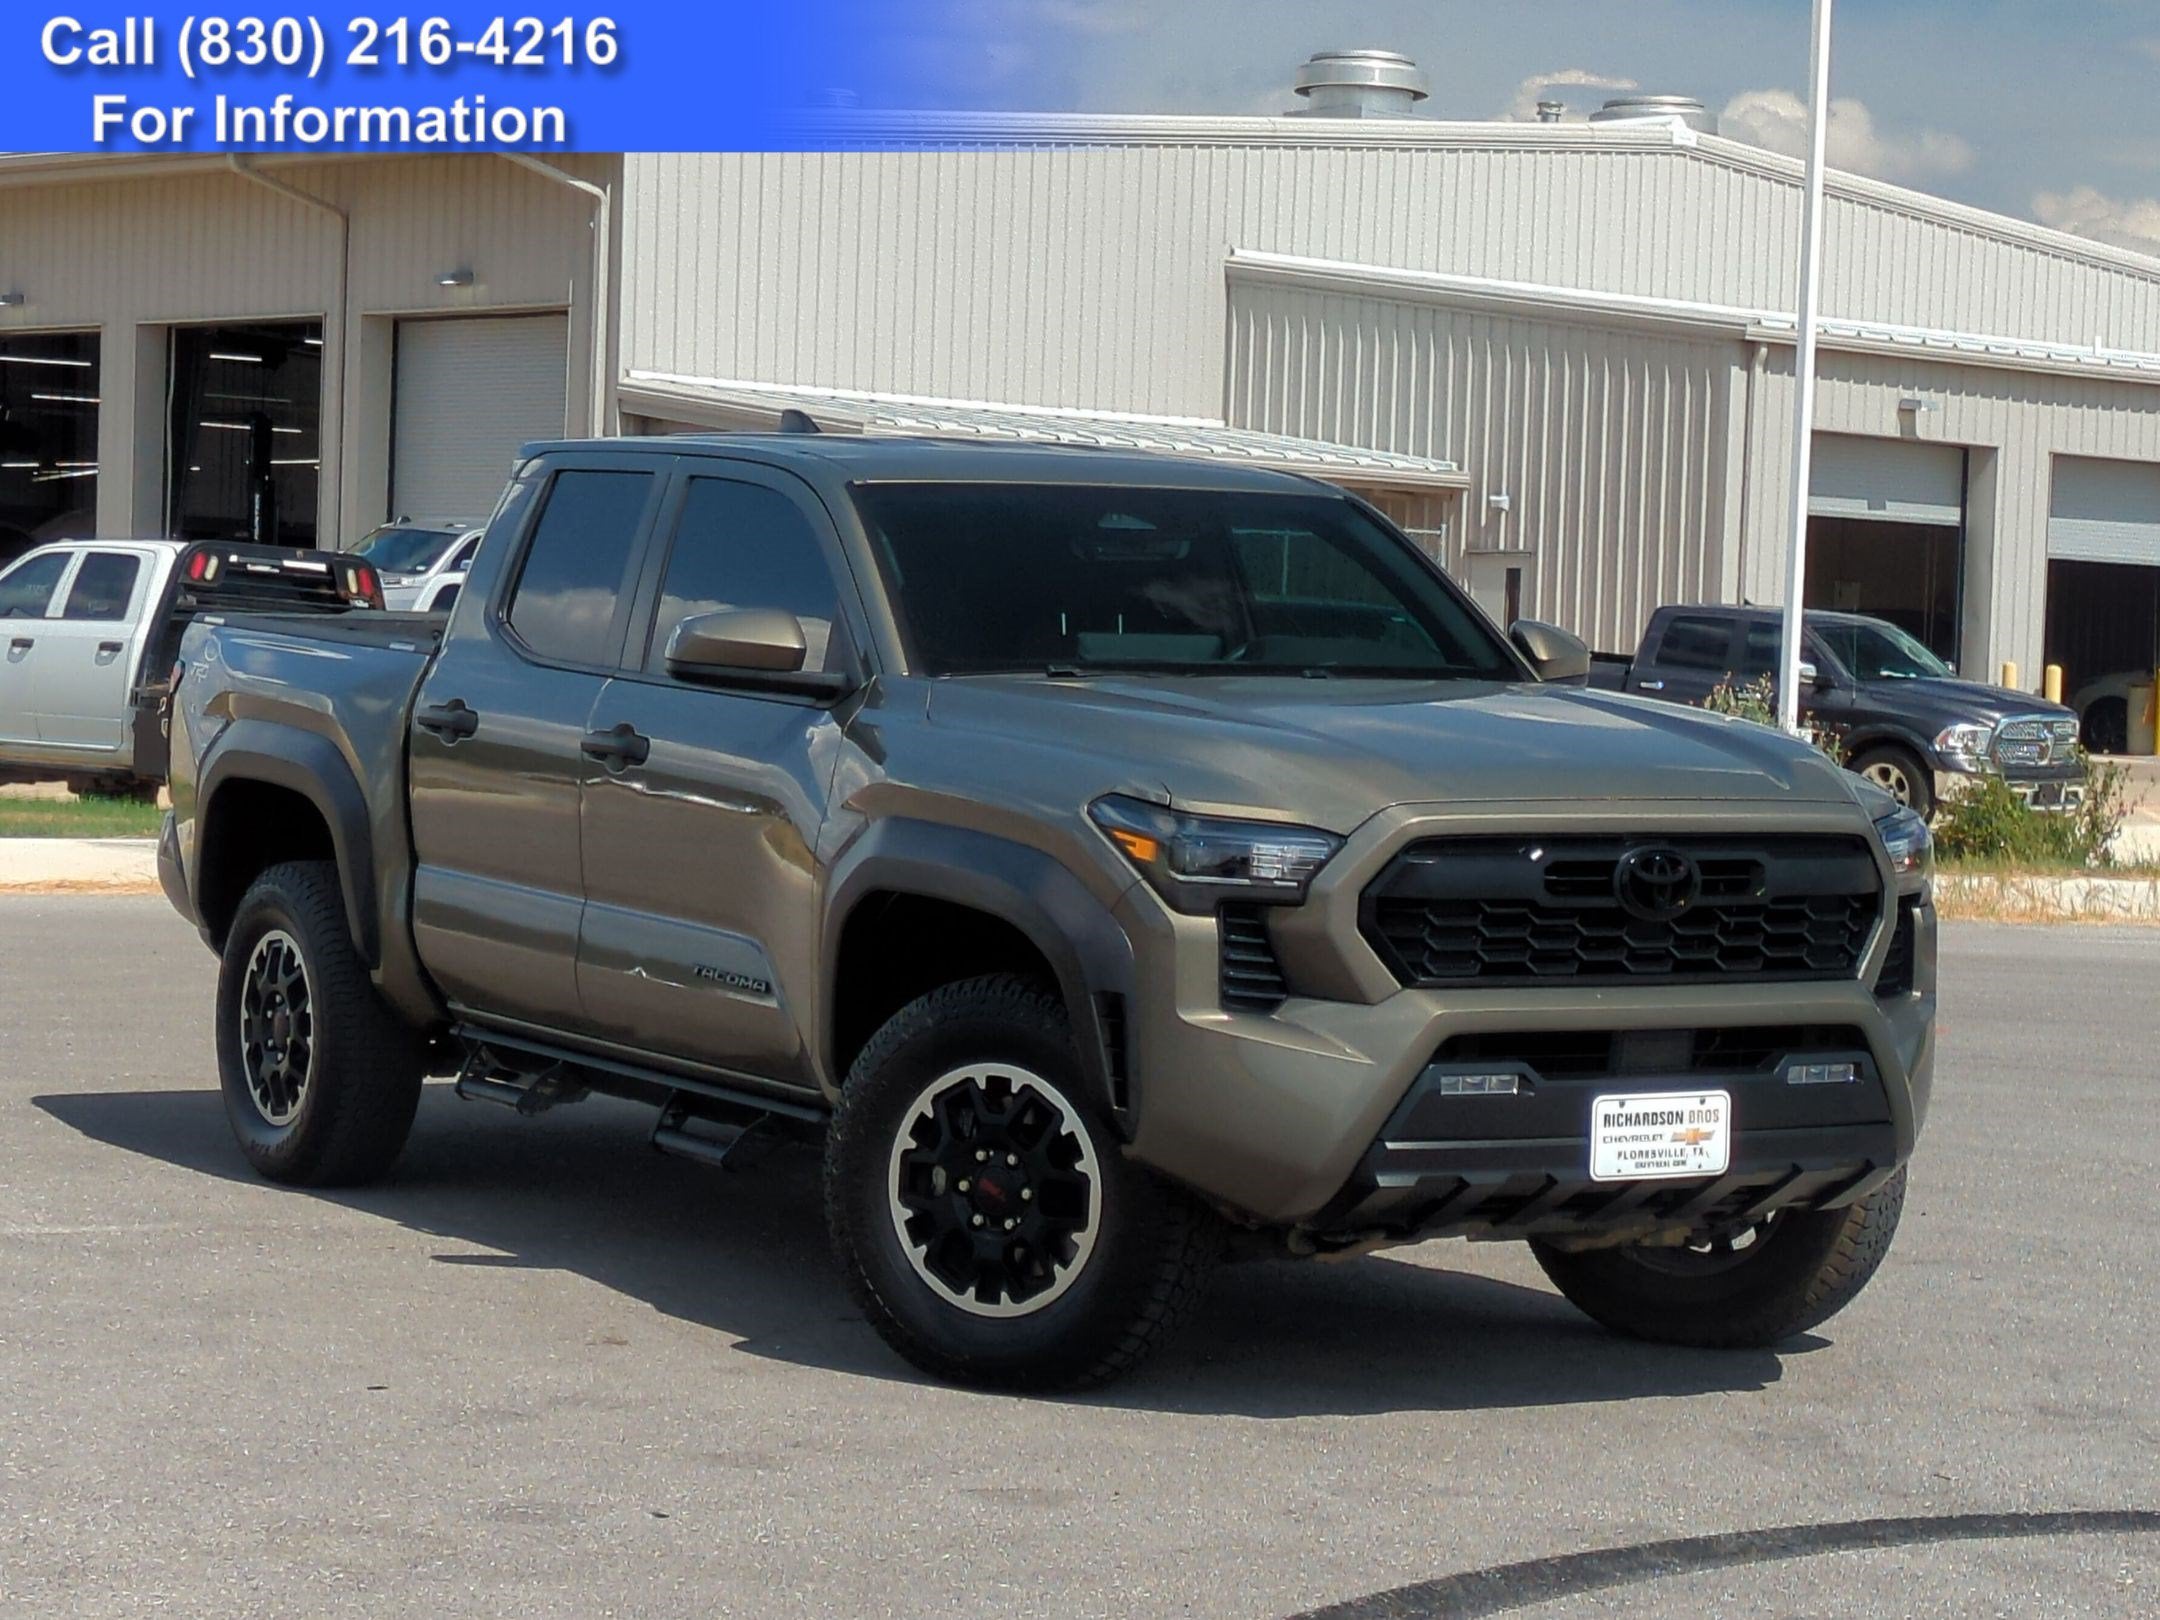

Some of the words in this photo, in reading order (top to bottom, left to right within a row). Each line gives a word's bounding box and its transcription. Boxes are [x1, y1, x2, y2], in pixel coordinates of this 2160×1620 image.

[693, 963, 771, 994] TACOMA
[1603, 1110, 1684, 1129] RICHARDSON
[1688, 1108, 1720, 1124] BROS
[1602, 1133, 1663, 1144] CHEVROLET
